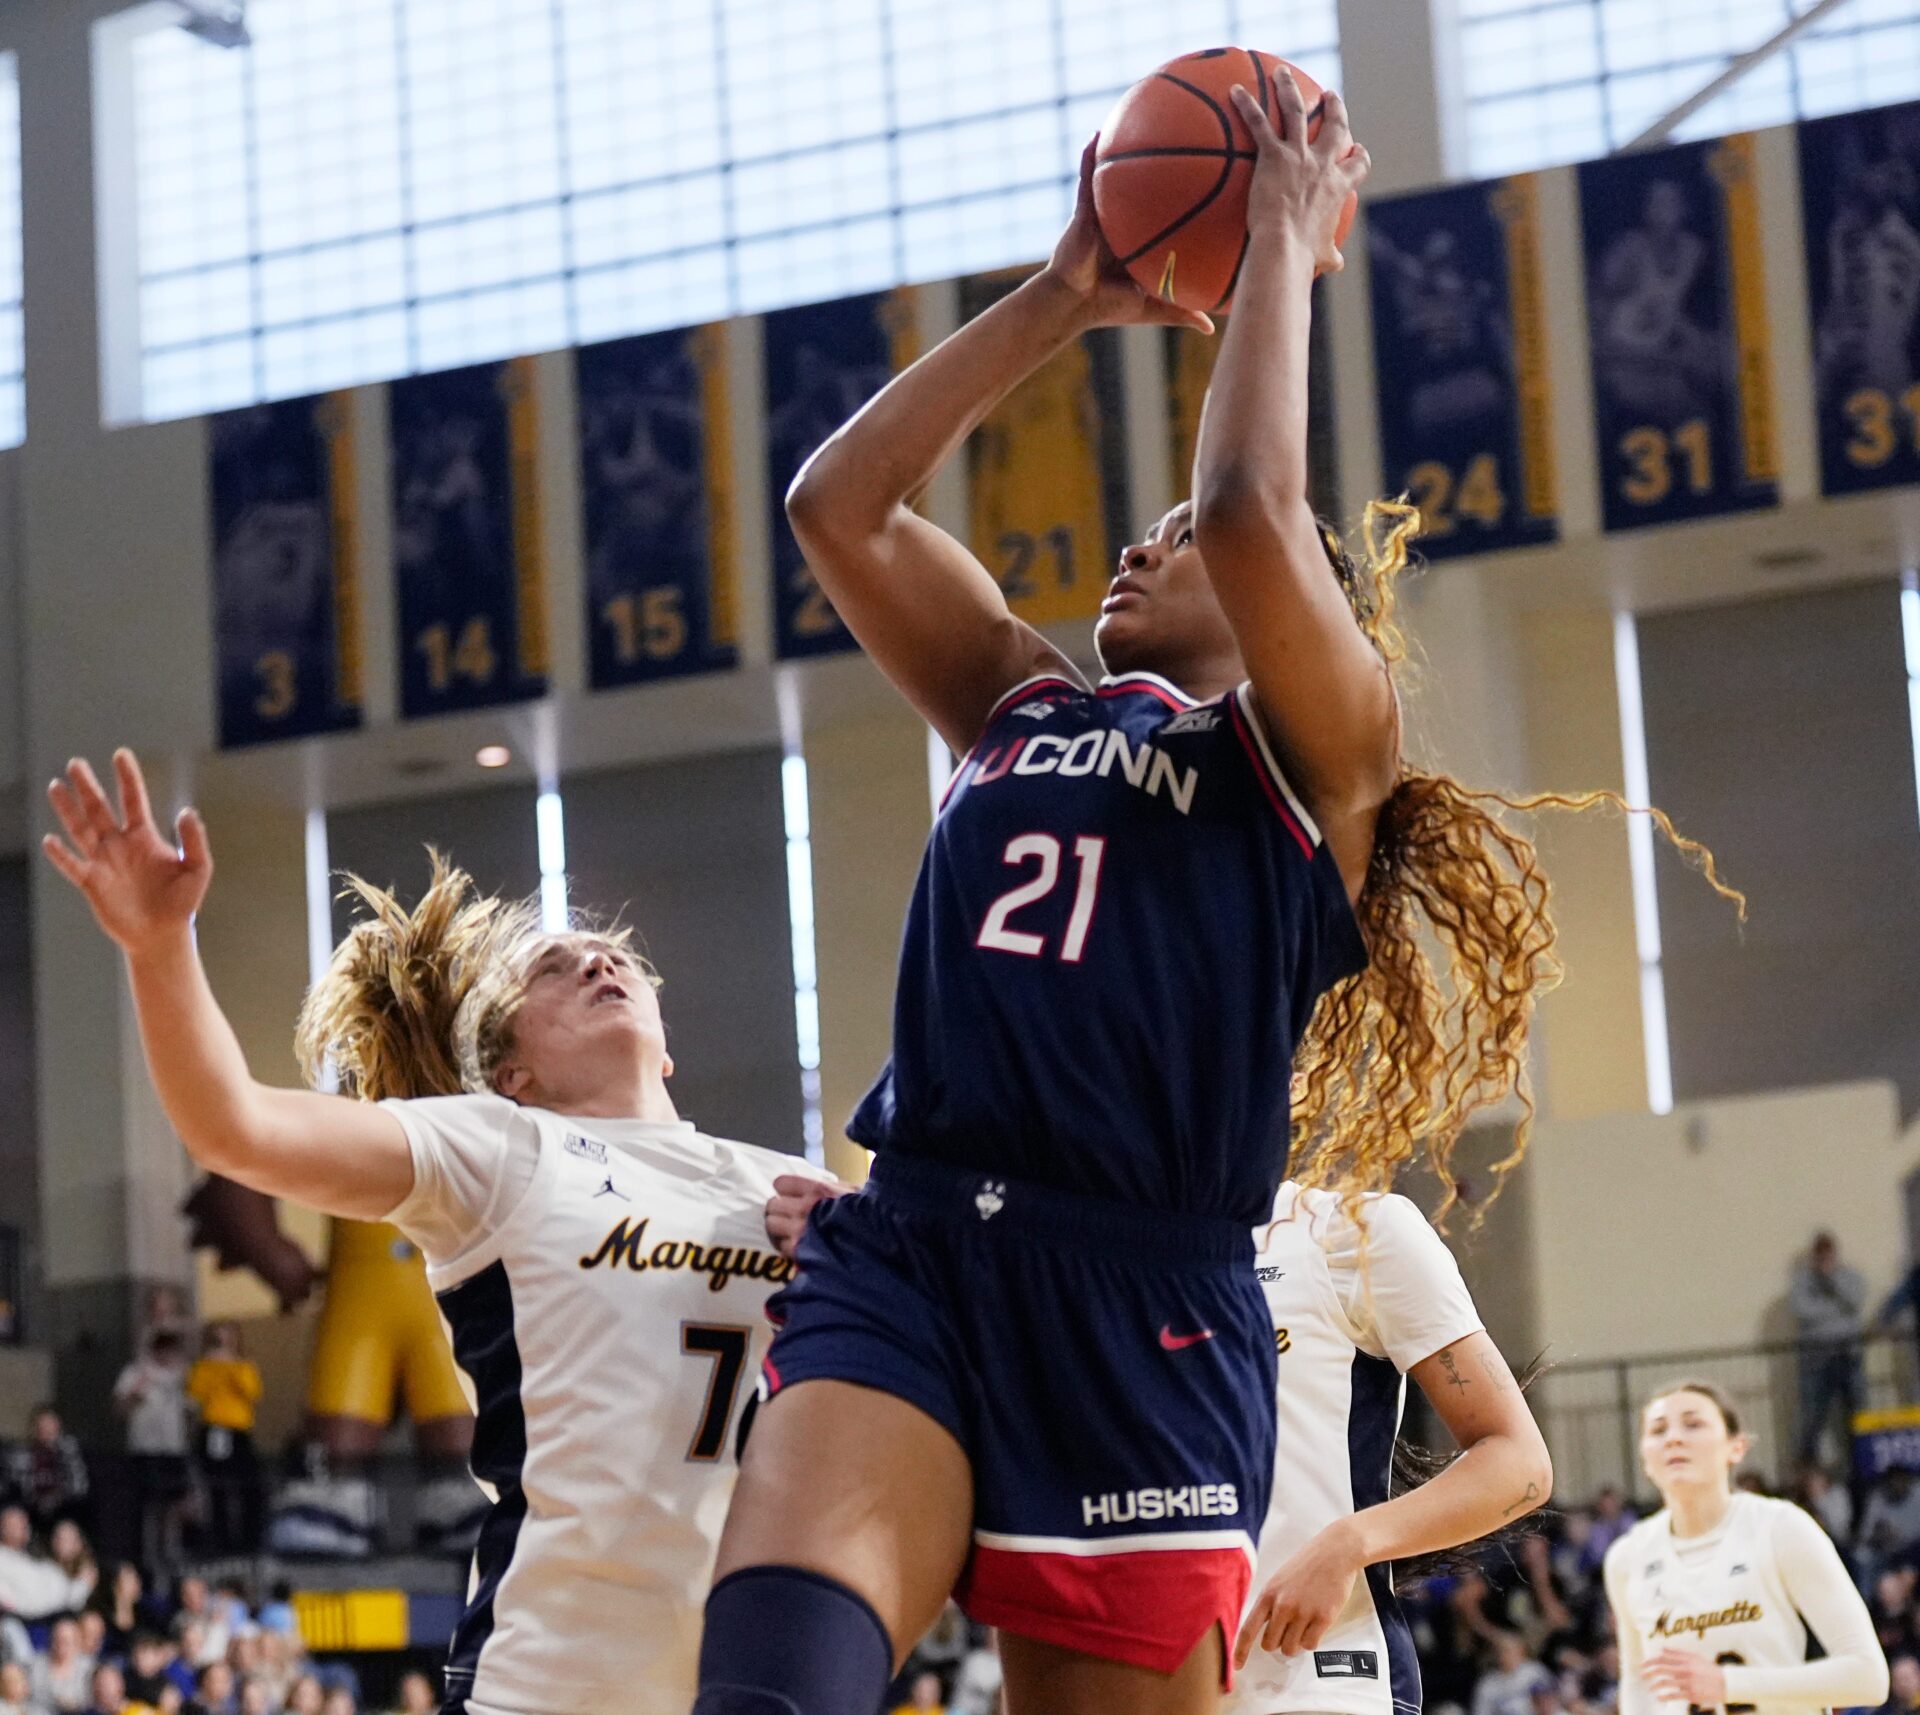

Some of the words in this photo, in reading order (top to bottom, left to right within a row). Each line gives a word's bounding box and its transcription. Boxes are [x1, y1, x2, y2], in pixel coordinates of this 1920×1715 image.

[1407, 454, 1504, 536] 24
[1620, 417, 1712, 504] 31
[997, 526, 1076, 598] 21
[415, 616, 495, 691] 14
[604, 585, 687, 663] 15
[254, 651, 297, 717] 3
[969, 729, 1199, 816] UCONN
[975, 832, 1108, 965] 21
[1257, 1272, 1287, 1282] AST
[679, 1319, 753, 1465] 7
[1082, 1483, 1239, 1527] HUSKIES
[1647, 1599, 1764, 1641] Marquette
[1360, 1658, 1369, 1670] L
